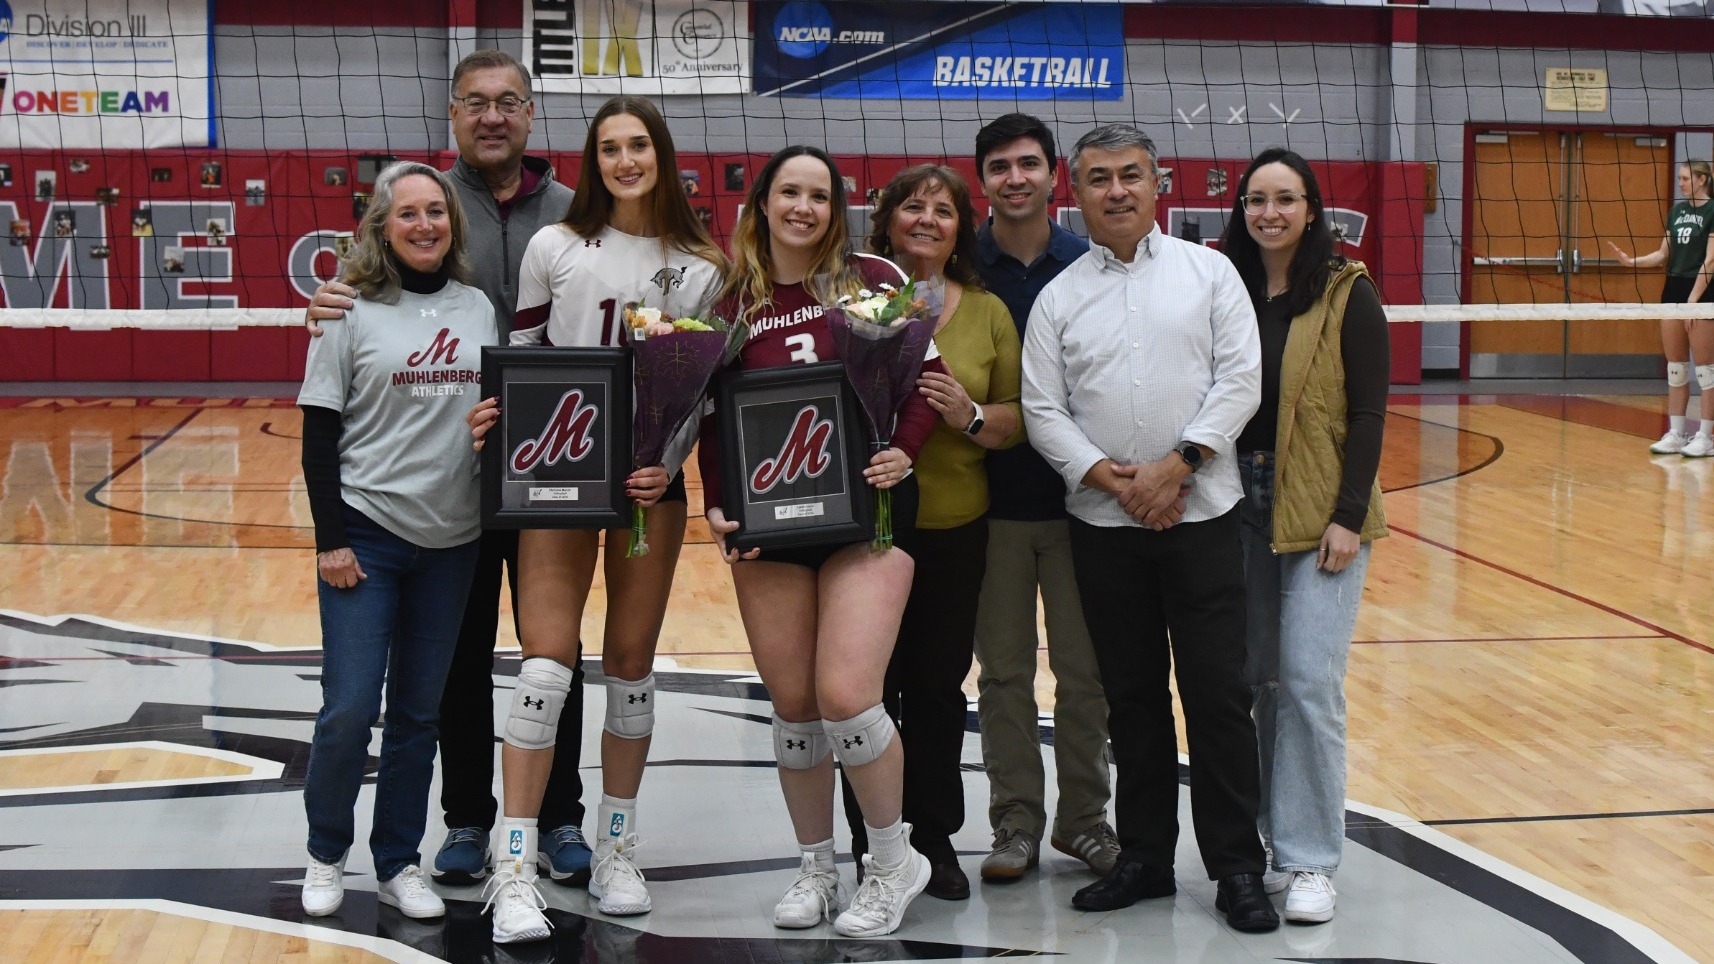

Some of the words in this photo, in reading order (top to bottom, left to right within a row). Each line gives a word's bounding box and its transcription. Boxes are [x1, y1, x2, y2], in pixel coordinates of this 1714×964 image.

[26, 14, 122, 38] Division
[131, 15, 147, 37] III
[780, 27, 885, 44] NCAA.com
[26, 41, 71, 49] DISCOVER
[76, 41, 117, 49] DEVELOP
[123, 41, 169, 49] DEDICATE
[682, 61, 743, 73] Anniversary
[932, 56, 1112, 89] BASKETBALL
[13, 90, 169, 113] ONETEAM
[1677, 227, 1692, 244] 18
[406, 327, 461, 367] M
[785, 333, 819, 364] 3
[411, 384, 464, 397] ATHLETICS
[510, 388, 599, 475] M
[750, 404, 835, 495] M
